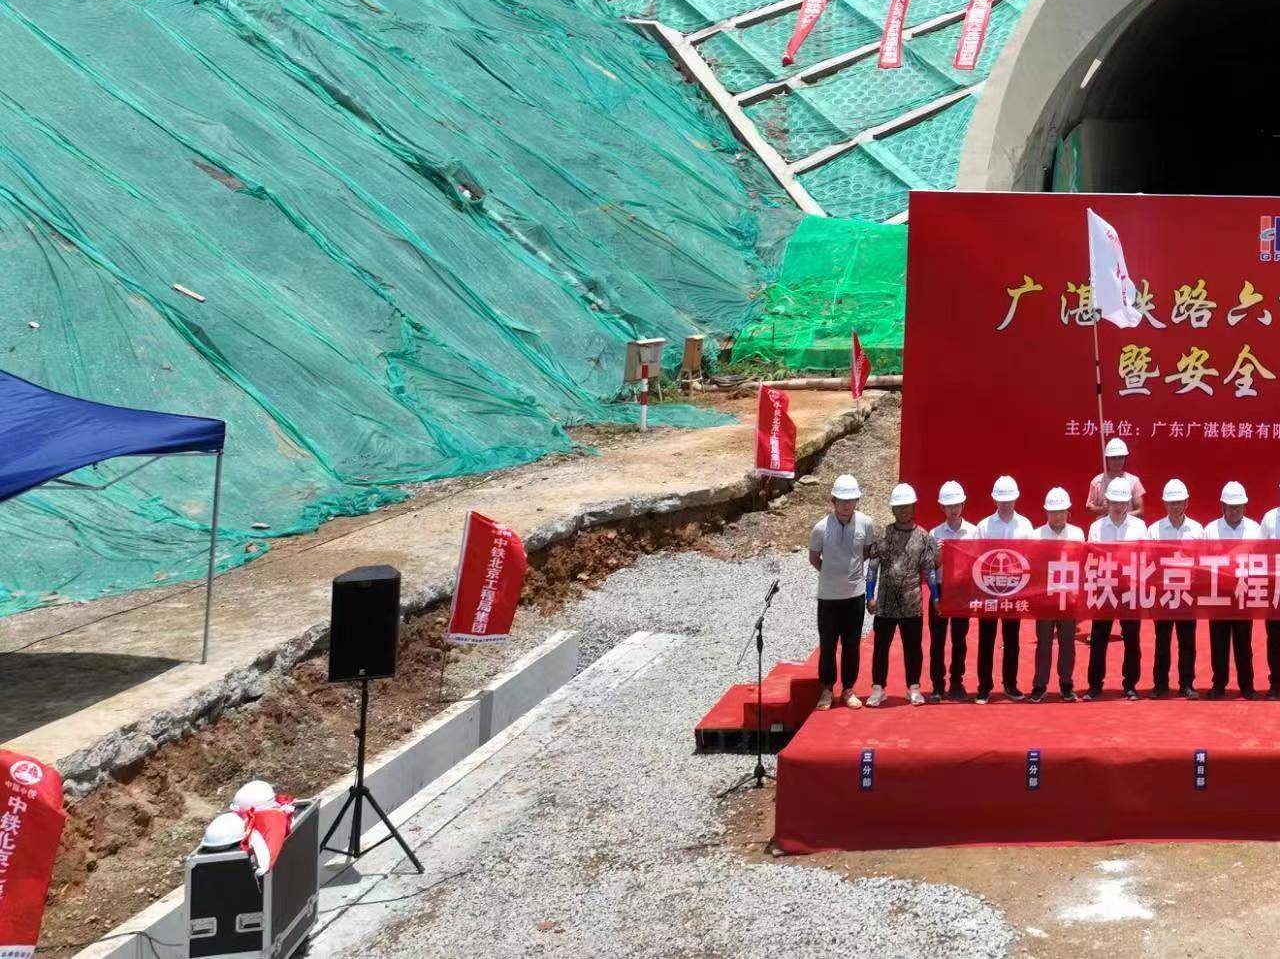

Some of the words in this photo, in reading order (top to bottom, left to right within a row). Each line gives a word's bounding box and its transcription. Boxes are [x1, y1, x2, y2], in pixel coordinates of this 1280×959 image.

[471, 538, 508, 634] 中铁北京工程局集团
[969, 599, 1030, 612] 中国中铁
